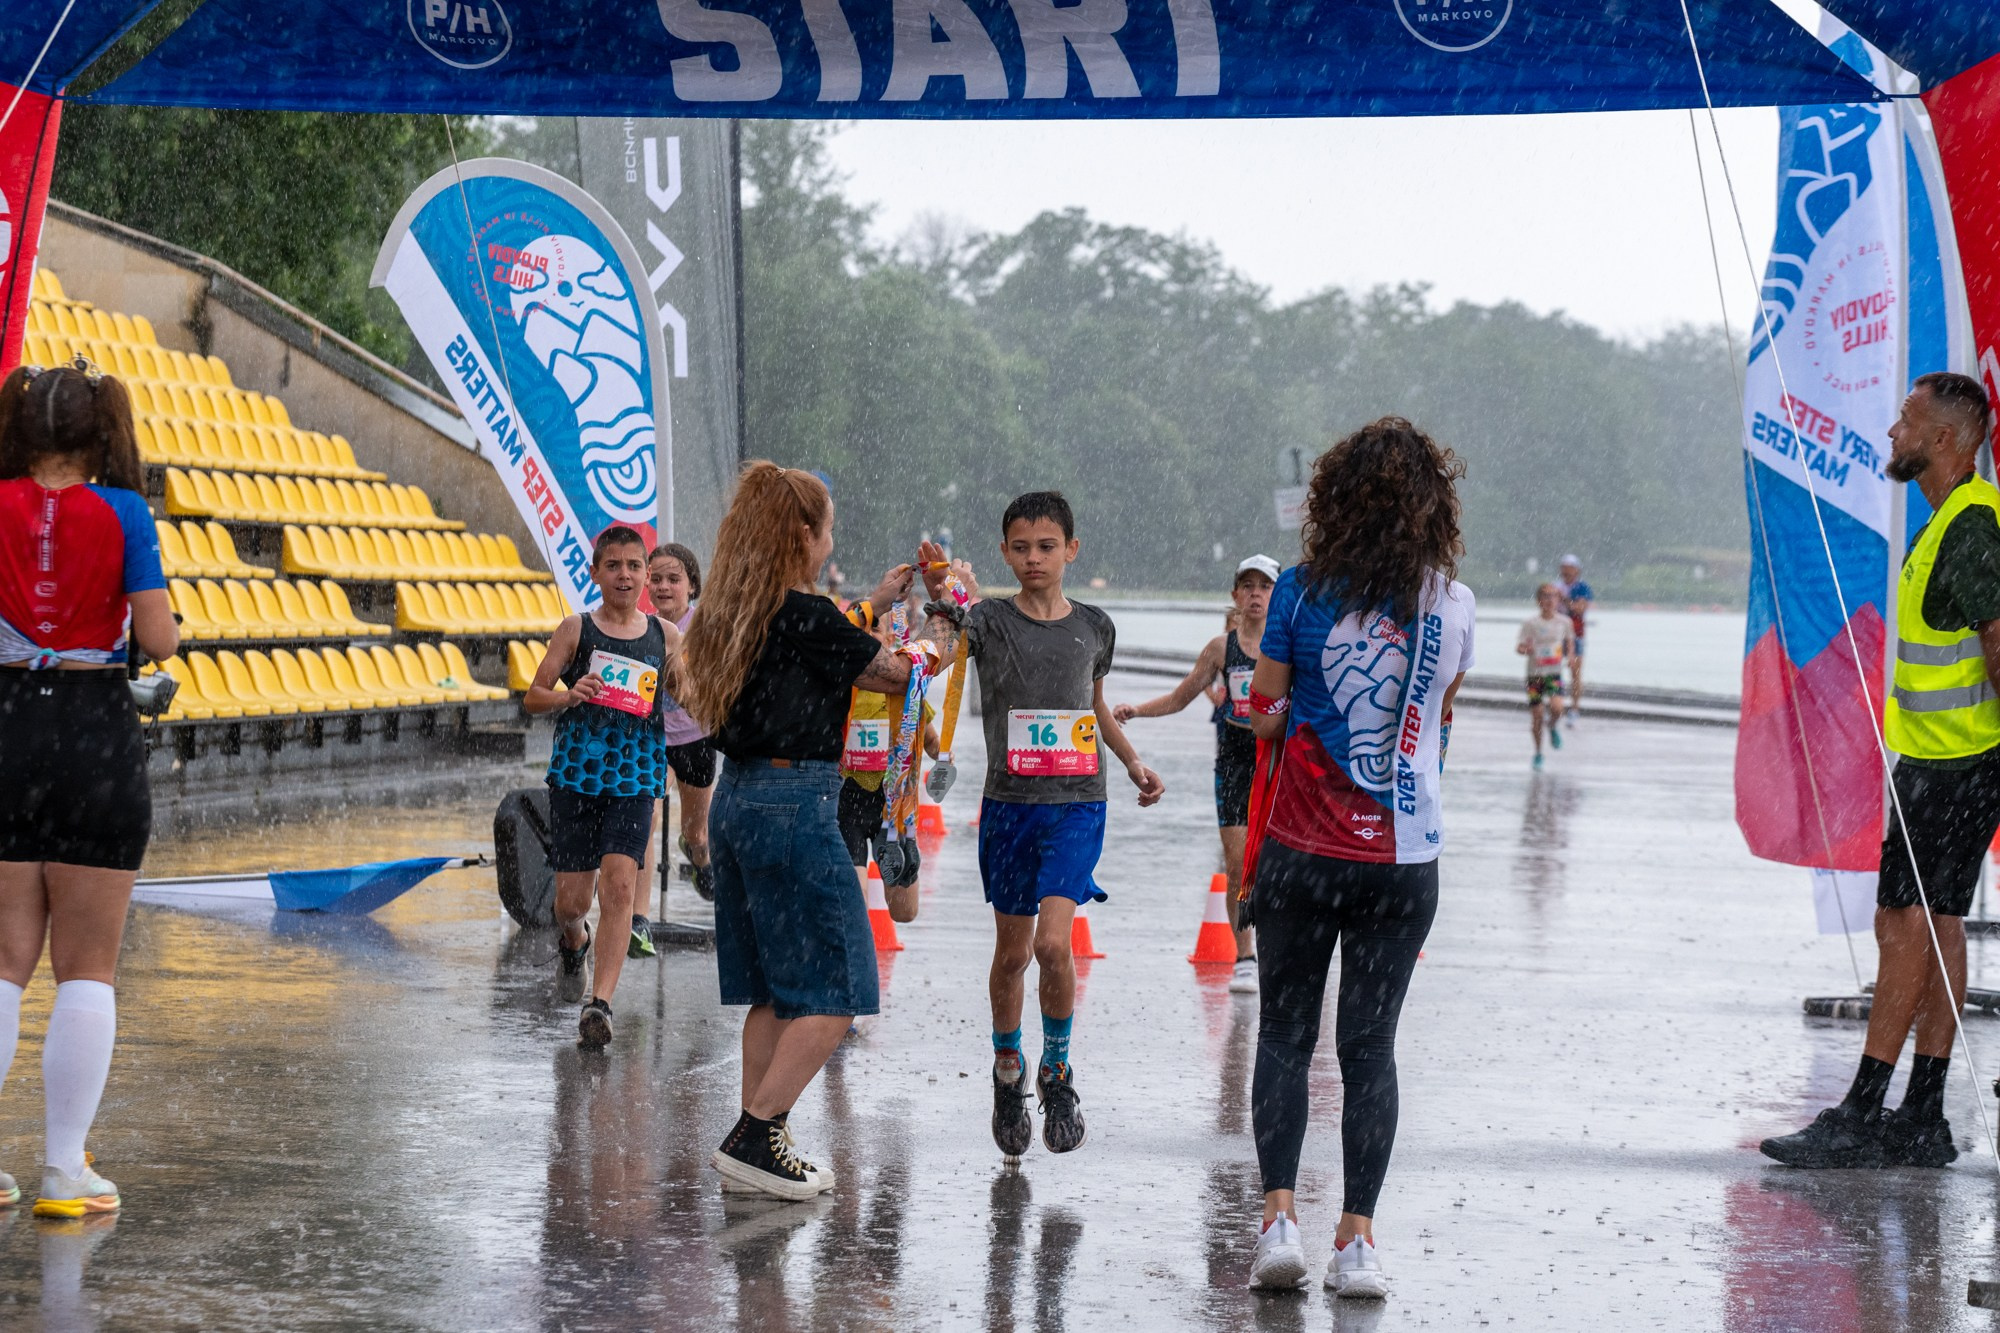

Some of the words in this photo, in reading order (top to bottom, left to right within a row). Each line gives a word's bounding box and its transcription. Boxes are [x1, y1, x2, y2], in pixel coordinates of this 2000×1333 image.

[424, 0, 493, 34] P/H
[1418, 9, 1493, 22] MARKOVO
[428, 32, 497, 46] MARKOVO
[1410, 613, 1443, 706] MATTERS
[601, 664, 630, 686] 64
[857, 730, 879, 748] 15
[1027, 723, 1058, 746] 16
[1399, 704, 1424, 758] STEP
[1396, 754, 1416, 816] EVERY
